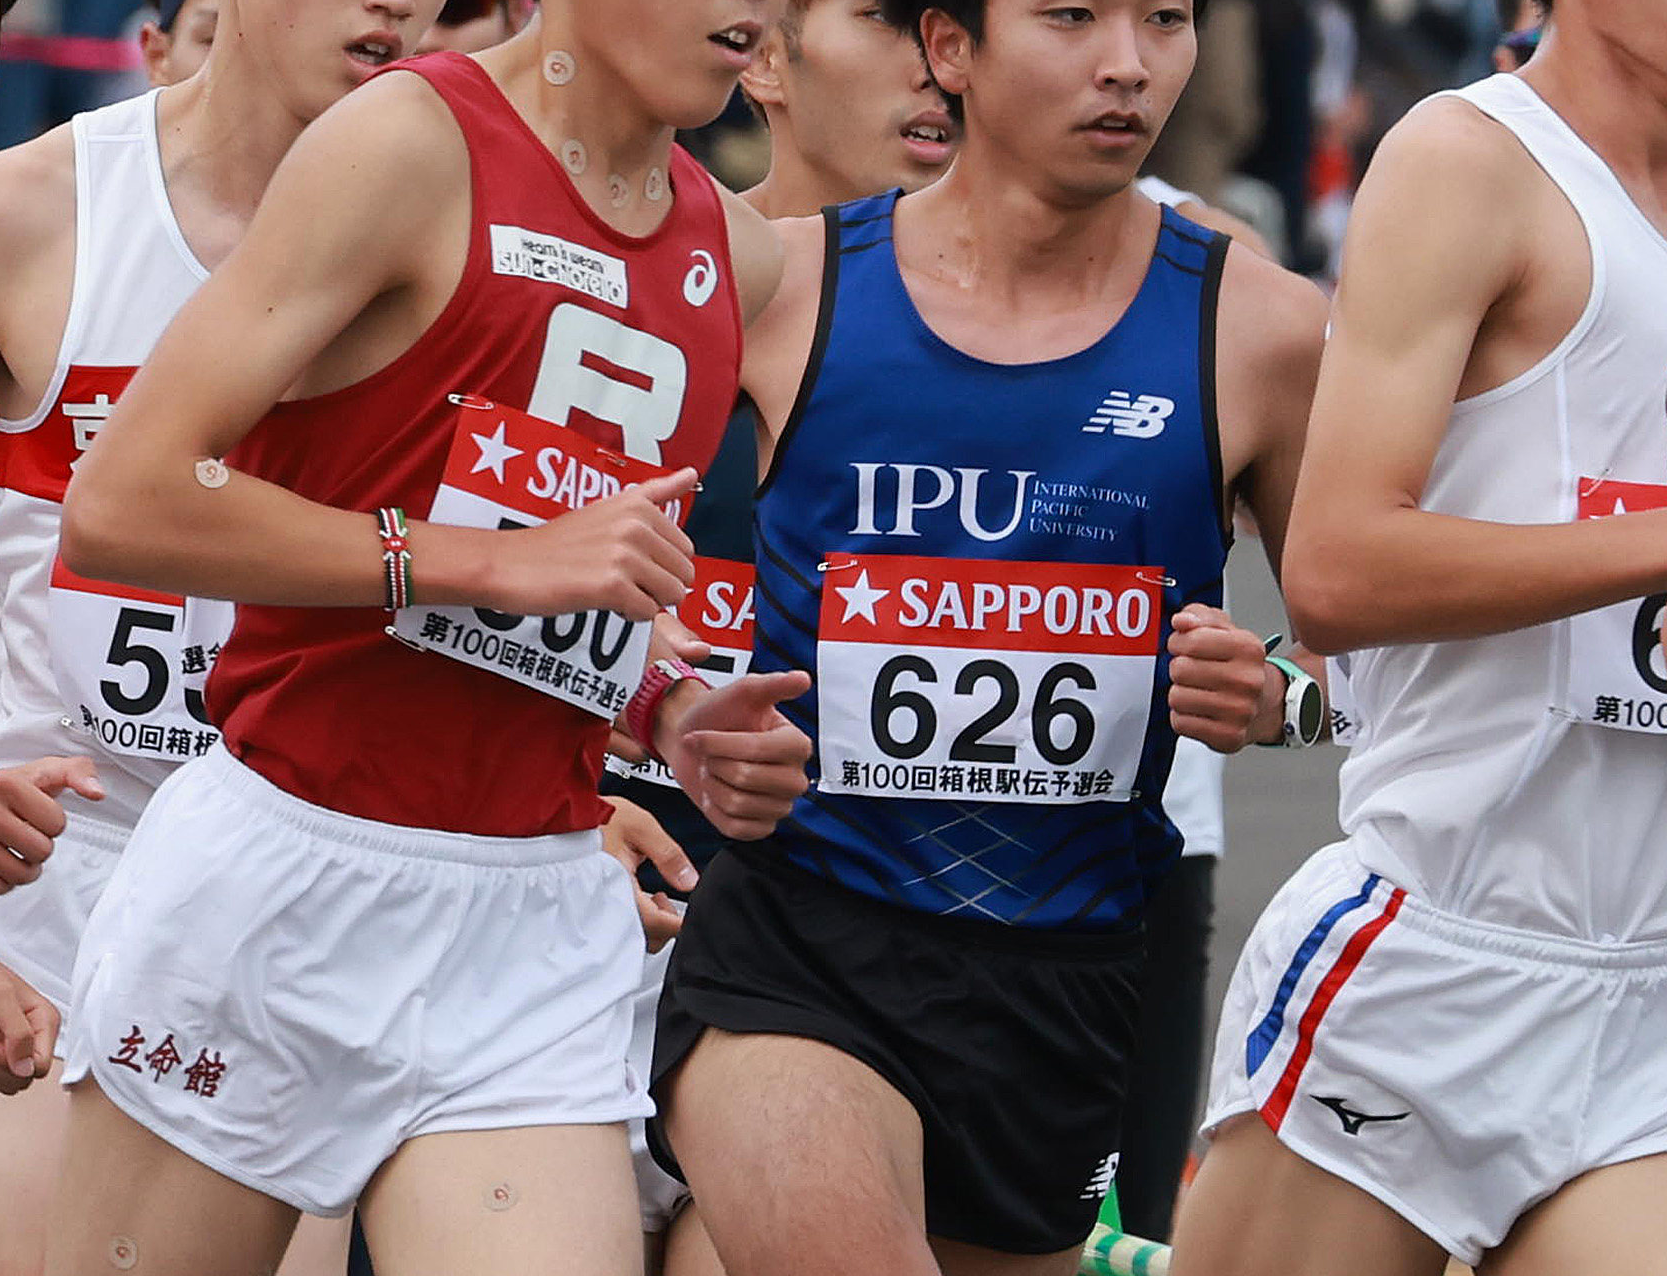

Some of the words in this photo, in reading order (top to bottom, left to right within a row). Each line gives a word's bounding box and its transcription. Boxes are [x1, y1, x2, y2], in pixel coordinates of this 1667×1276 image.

[527, 303, 687, 466] R
[848, 462, 1037, 542] IPU
[897, 577, 1151, 639] SAPPORO
[871, 654, 1097, 766] 626
[842, 760, 1115, 798] 第100回箱根駅伝予選会
